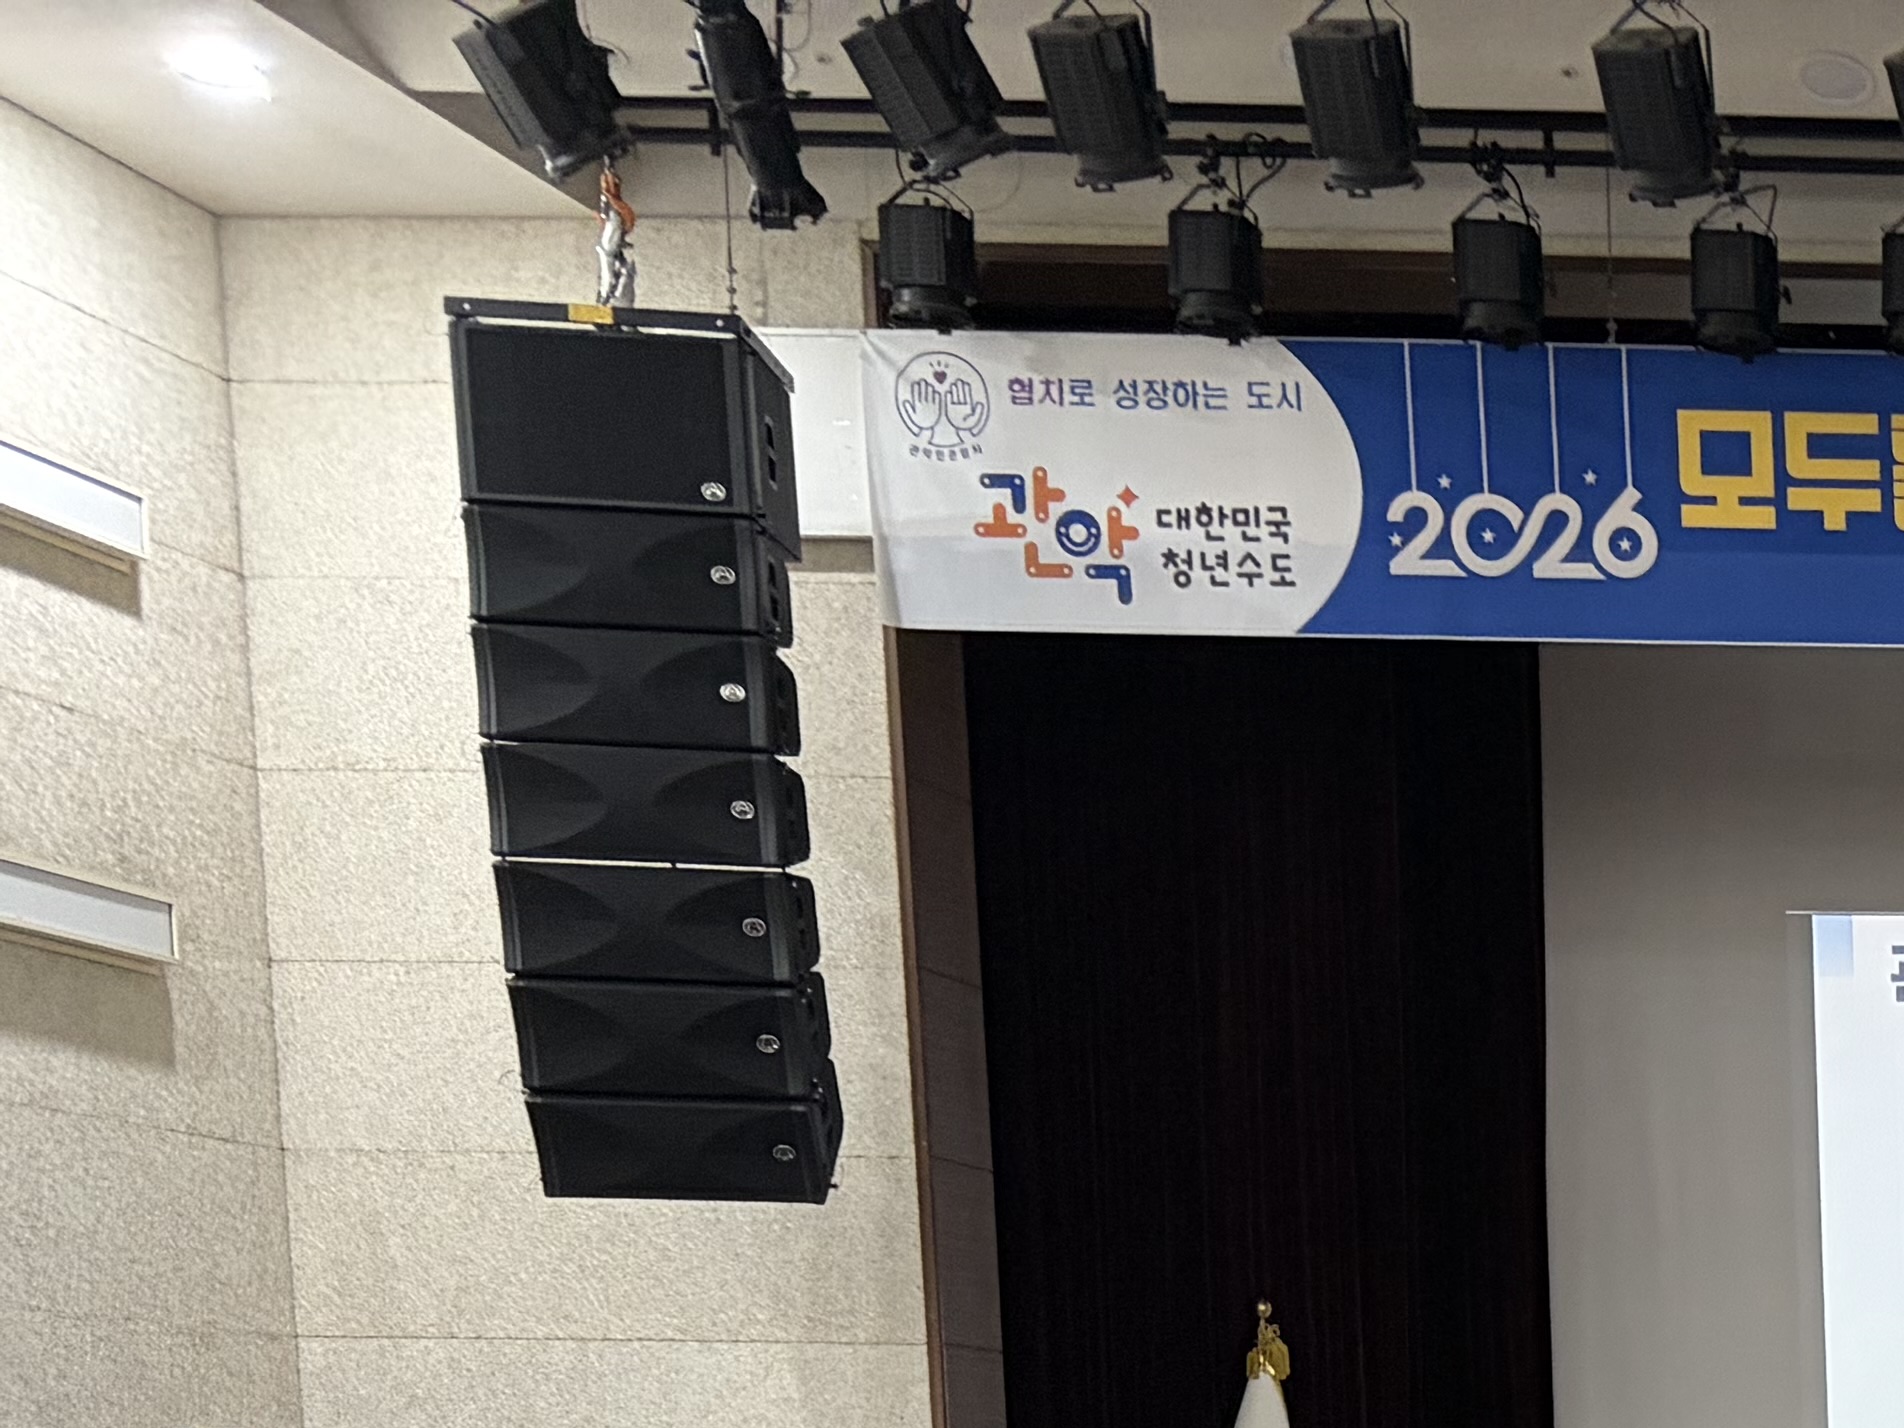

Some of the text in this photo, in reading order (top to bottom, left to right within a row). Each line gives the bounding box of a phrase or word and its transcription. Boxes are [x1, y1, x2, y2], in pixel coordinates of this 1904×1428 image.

[1007, 376, 1303, 413] 협치로 성장하는 도시
[1155, 501, 1292, 544] 대한민국
[1386, 484, 1660, 581] 2026
[1160, 547, 1297, 589] 청년수도
